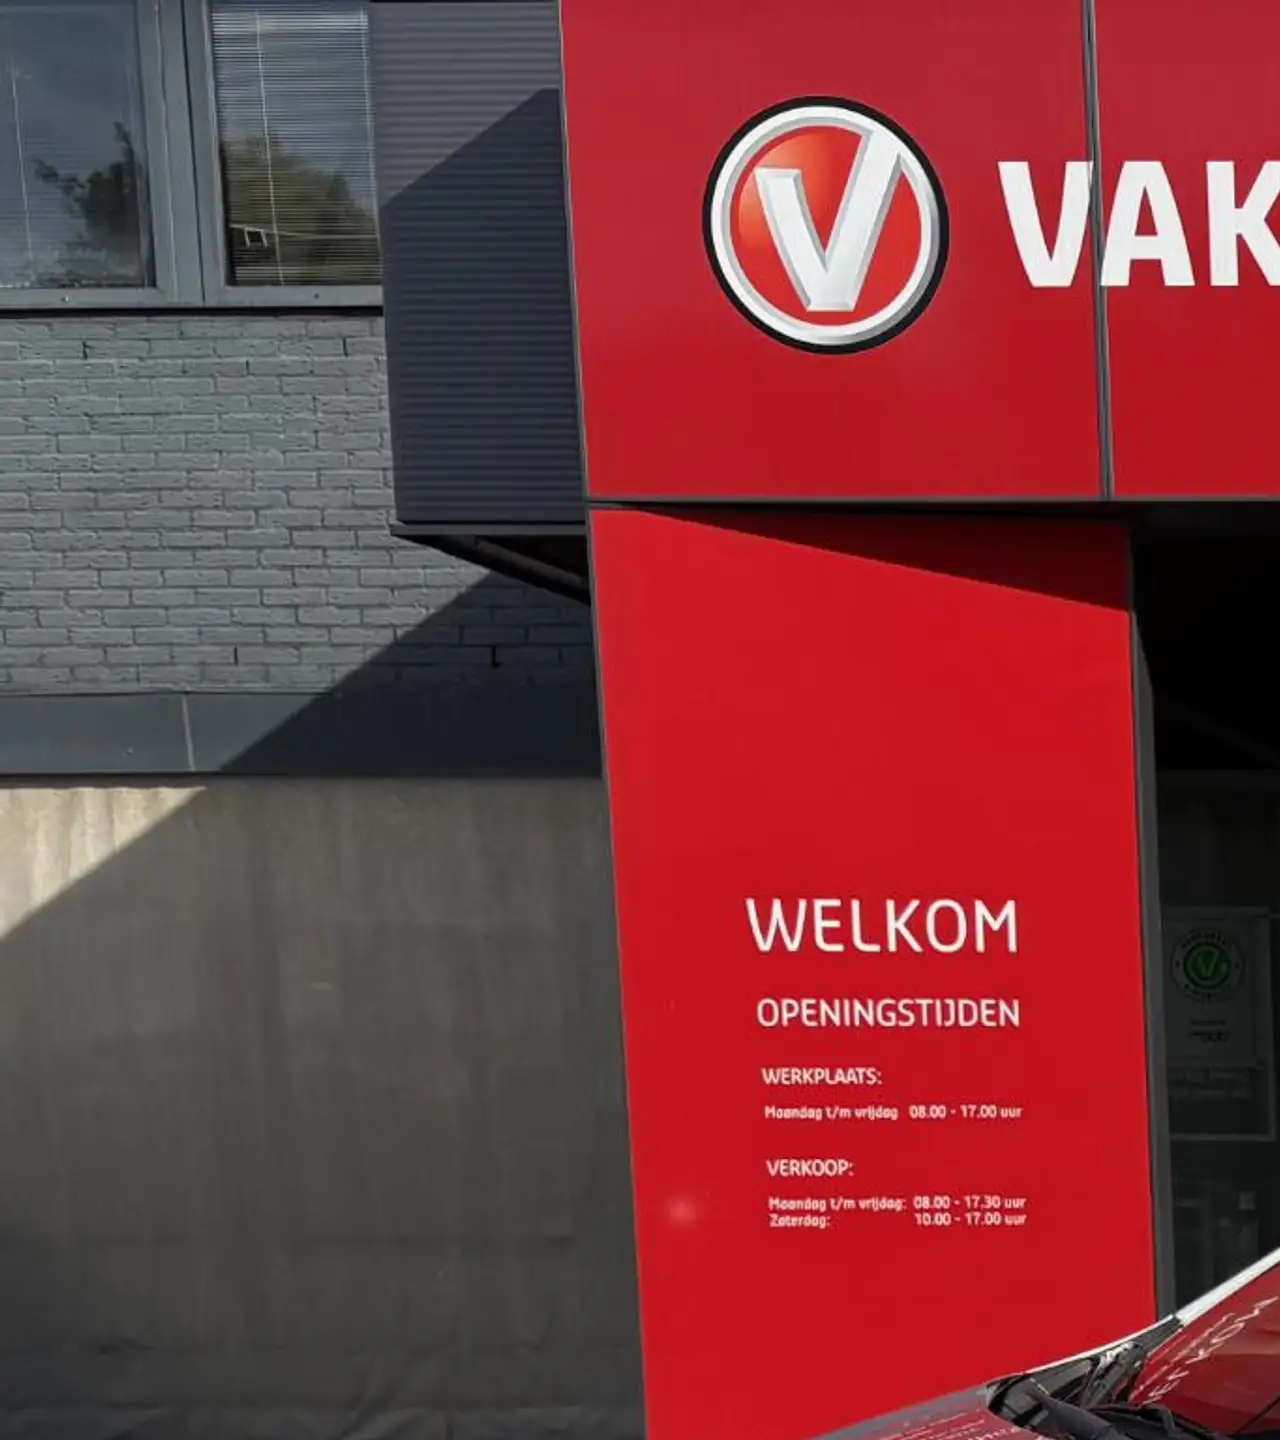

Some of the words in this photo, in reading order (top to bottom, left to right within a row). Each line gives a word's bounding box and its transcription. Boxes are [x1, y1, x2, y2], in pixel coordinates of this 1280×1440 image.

[745, 897, 1018, 954] WELKOM
[756, 997, 1020, 1028] OPENINGSTIJDEN
[761, 1066, 883, 1086] WERKPLAATS:
[765, 1105, 822, 1121] Maandag
[826, 1104, 852, 1119] t/m
[909, 1104, 947, 1119] 08.00
[960, 1104, 998, 1119] 17.00
[1000, 1105, 1022, 1118] uur
[765, 1158, 854, 1177] VERKOOP:
[769, 1196, 827, 1212] Maandag
[830, 1195, 856, 1210] t/m
[914, 1194, 951, 1209] 08.00
[1004, 1196, 1026, 1209] uur
[769, 1212, 830, 1228] Zaterdag:
[965, 1211, 1003, 1226] 17.00
[1004, 1213, 1027, 1226] uur
